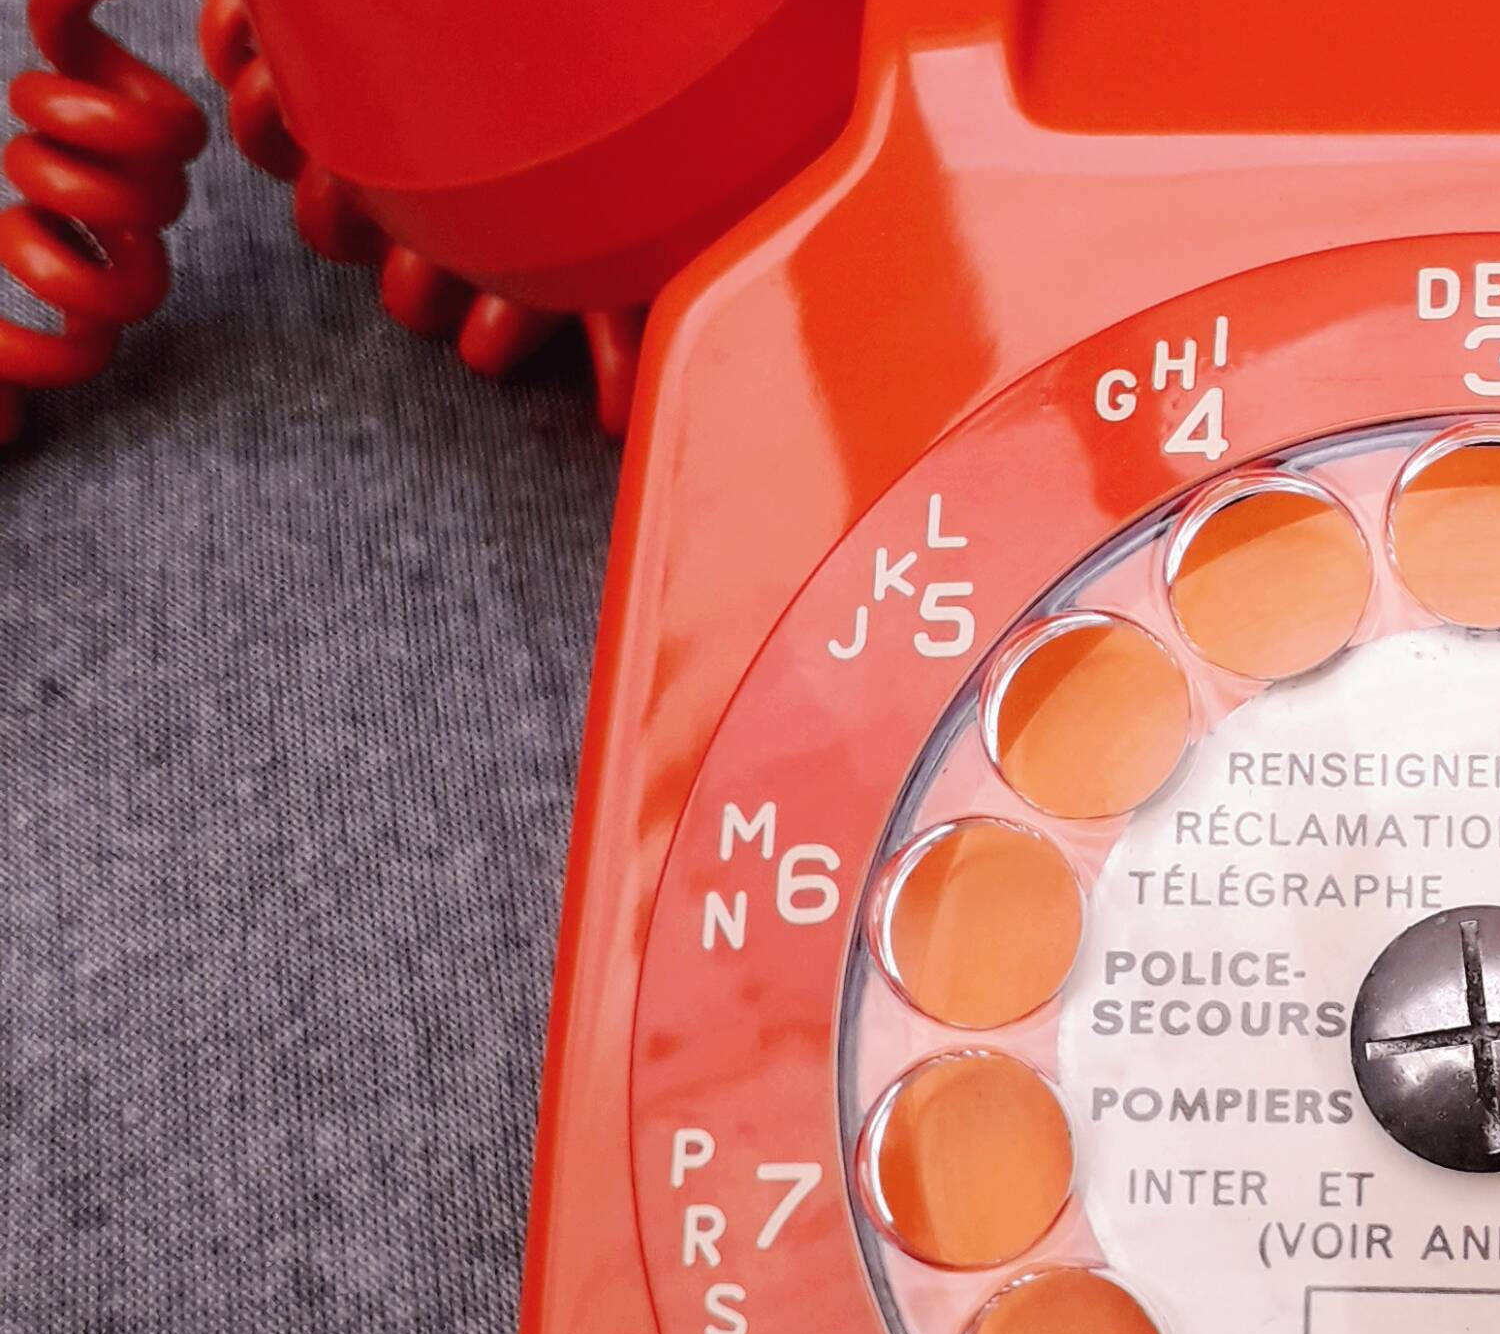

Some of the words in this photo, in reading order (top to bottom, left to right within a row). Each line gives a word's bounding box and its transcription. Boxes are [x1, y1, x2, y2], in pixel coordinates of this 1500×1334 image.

[1163, 387, 1229, 461] 4
[913, 581, 975, 657] 5
[775, 843, 840, 925] 6
[1129, 867, 1444, 910] TÉLÉGRAPHE
[1104, 950, 1307, 988] POLICE-
[1091, 998, 1347, 1038] SECOURS
[1091, 1087, 1354, 1125] POMPIERS
[756, 1161, 822, 1250] 7
[1128, 1168, 1269, 1208] INTER
[1319, 1171, 1374, 1208] ET
[1257, 1221, 1393, 1270] (VOIR
